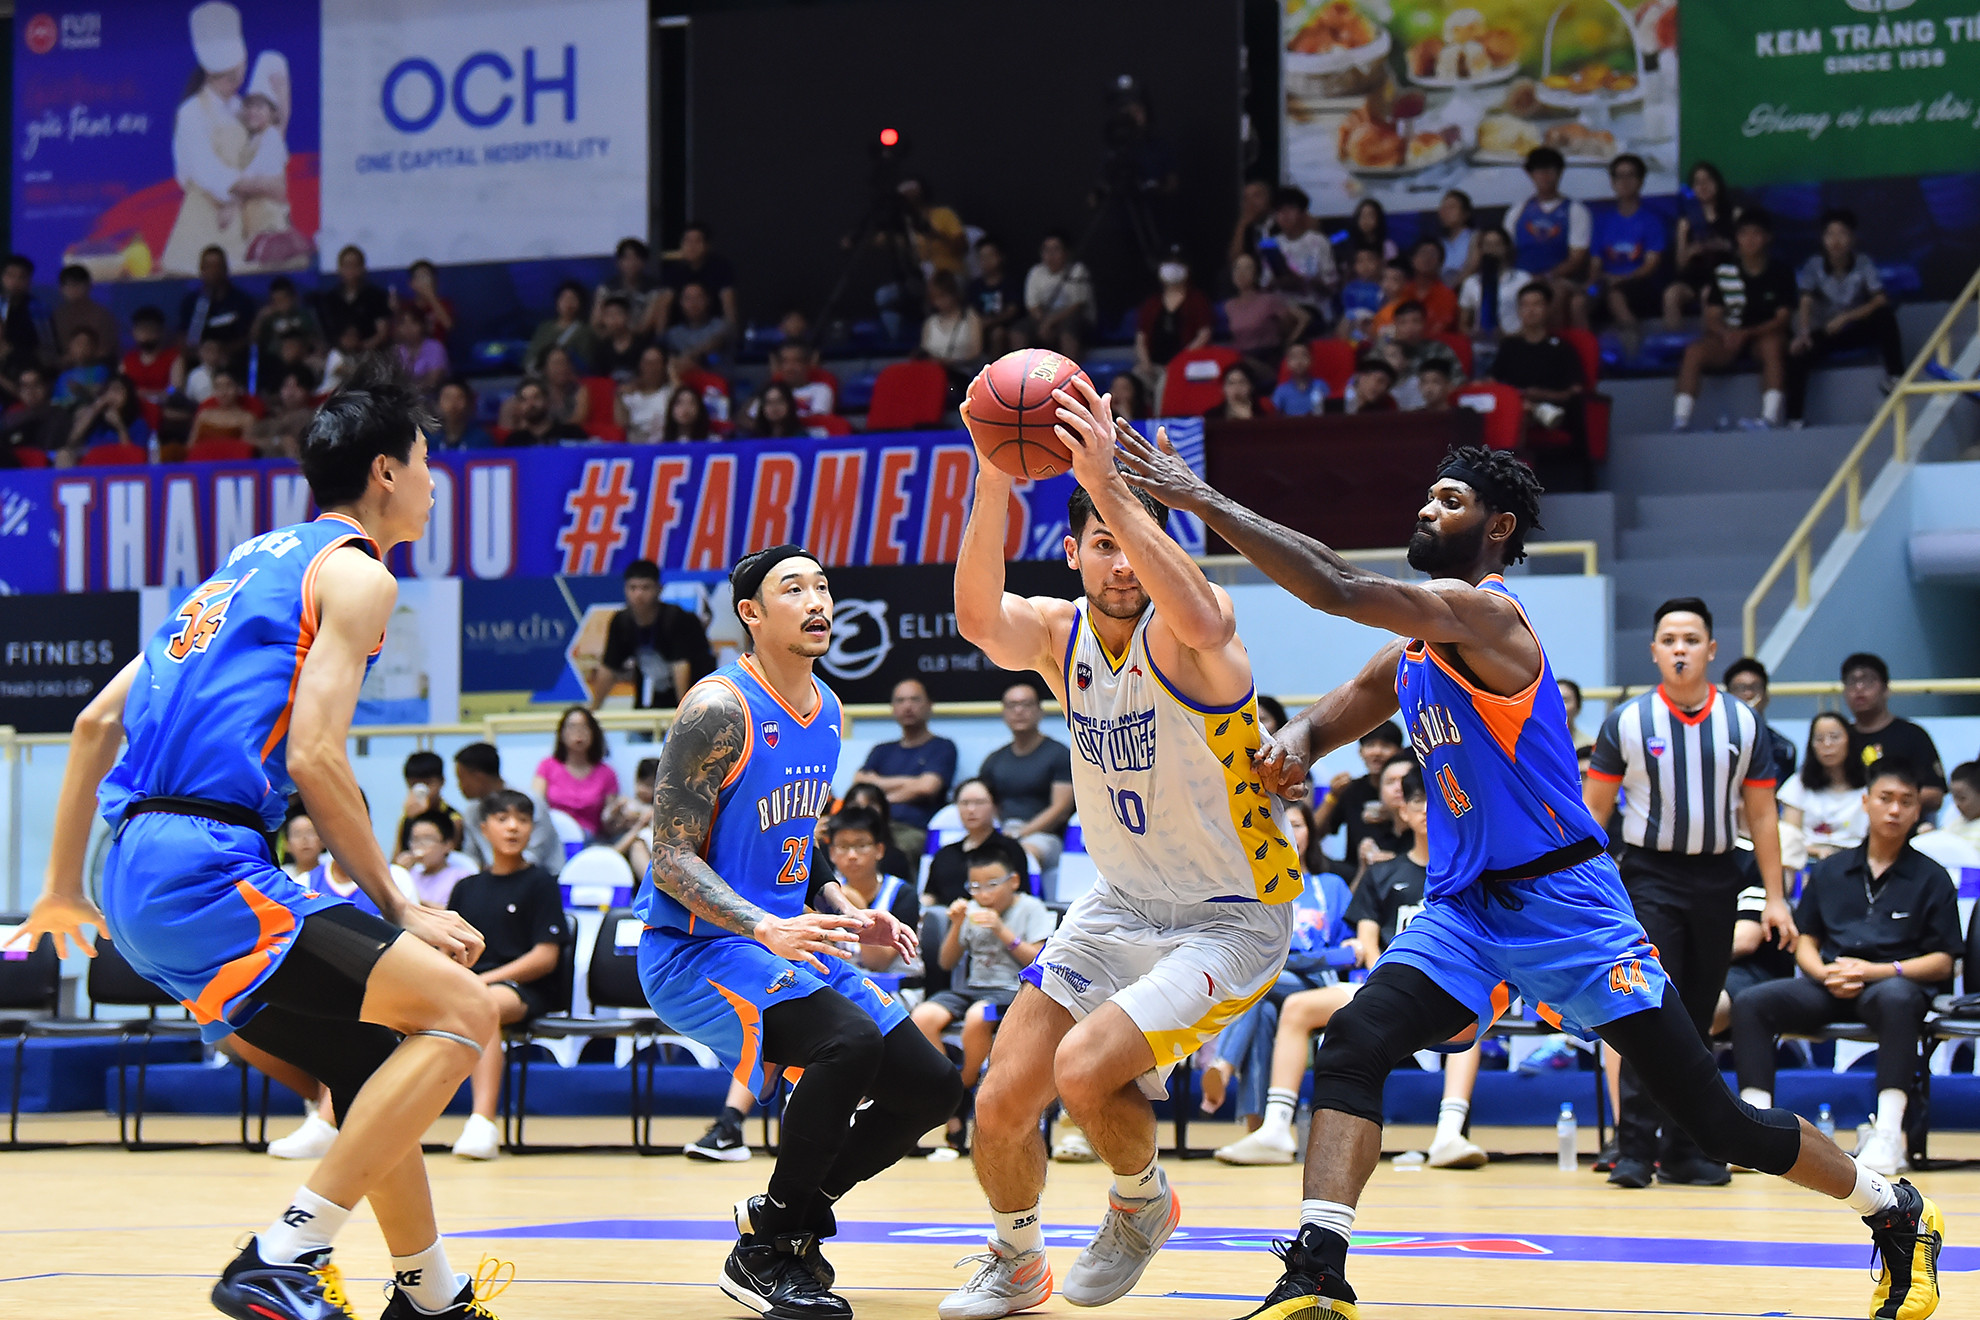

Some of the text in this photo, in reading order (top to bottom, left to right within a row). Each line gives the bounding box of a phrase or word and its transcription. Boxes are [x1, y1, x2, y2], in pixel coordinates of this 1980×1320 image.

[1755, 28, 1822, 57] KEM
[1823, 52, 1892, 75] SINCE
[381, 44, 576, 134] OCH
[355, 136, 611, 174] ONE CAPITAL HOSPITALITY
[407, 460, 517, 580] OU
[900, 612, 957, 639] ELIT
[5, 639, 114, 666] FITNESS
[764, 724, 778, 734] VBA
[785, 764, 827, 775] HANOI
[1435, 763, 1473, 819] 44
[1609, 959, 1652, 996] 44
